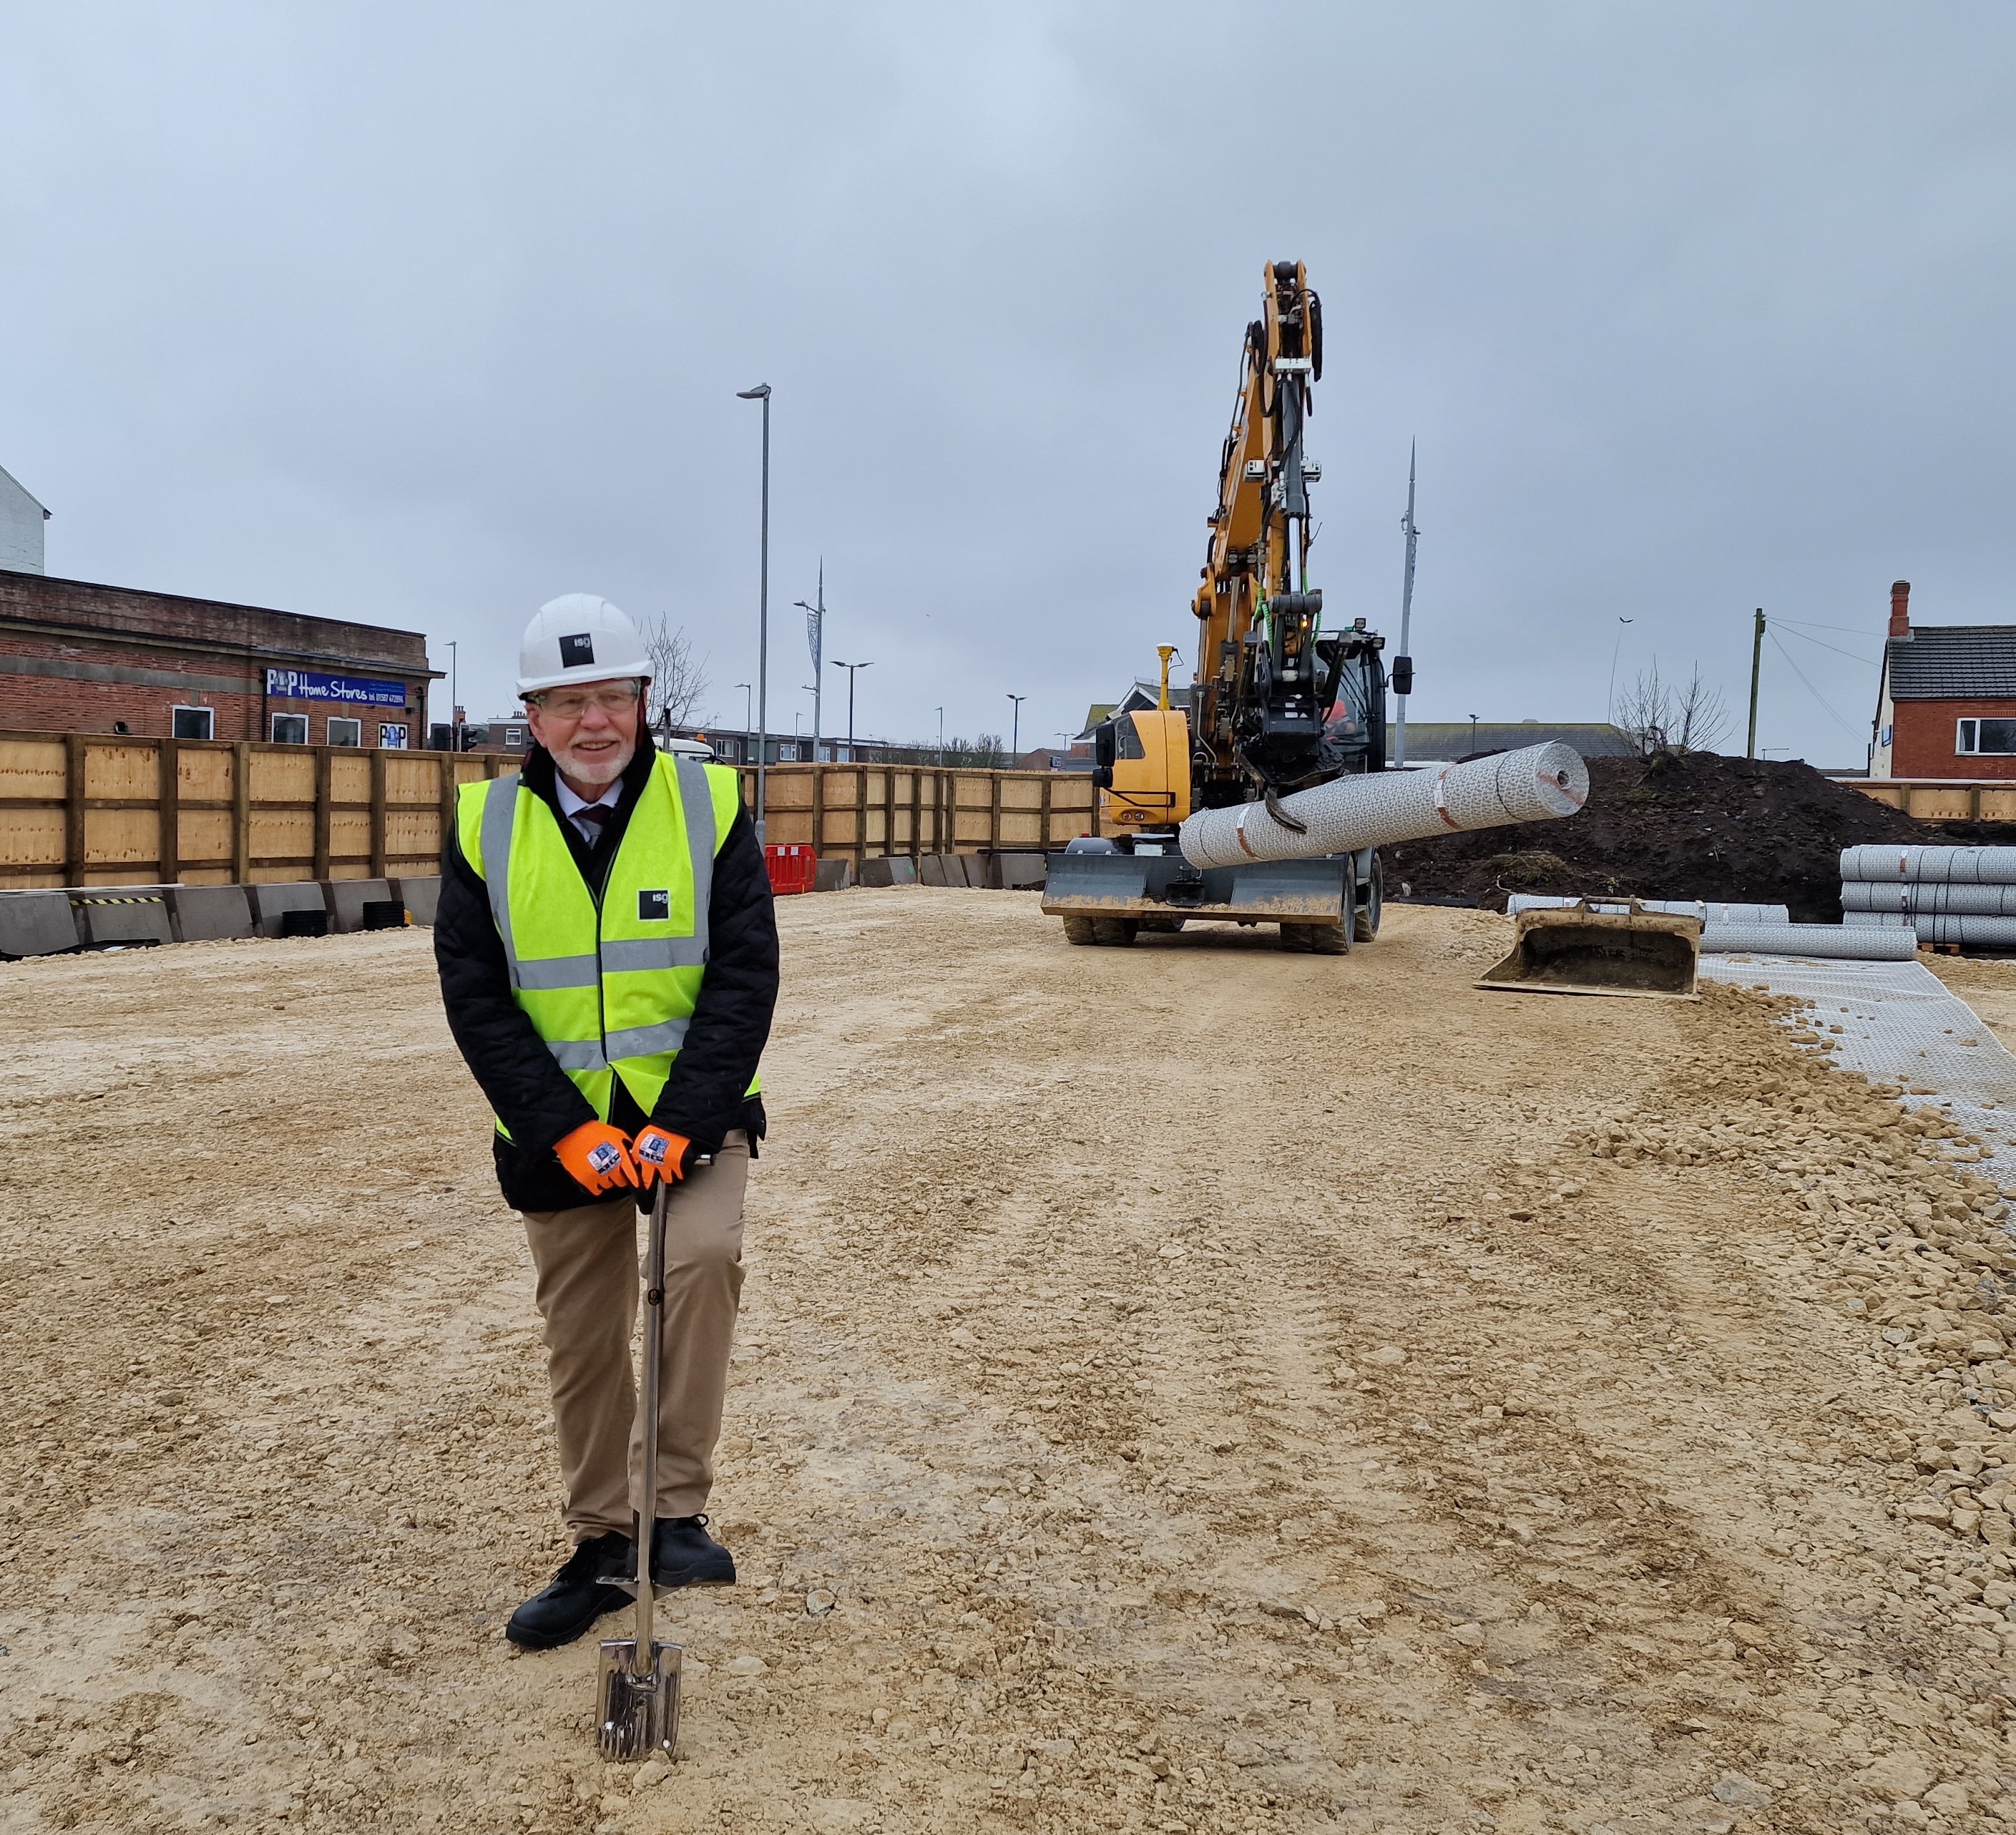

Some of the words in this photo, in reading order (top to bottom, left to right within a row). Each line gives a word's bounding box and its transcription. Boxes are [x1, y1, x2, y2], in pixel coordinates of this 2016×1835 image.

[298, 673, 329, 698] Home
[331, 680, 368, 700] Stores
[652, 894, 668, 904] isg
